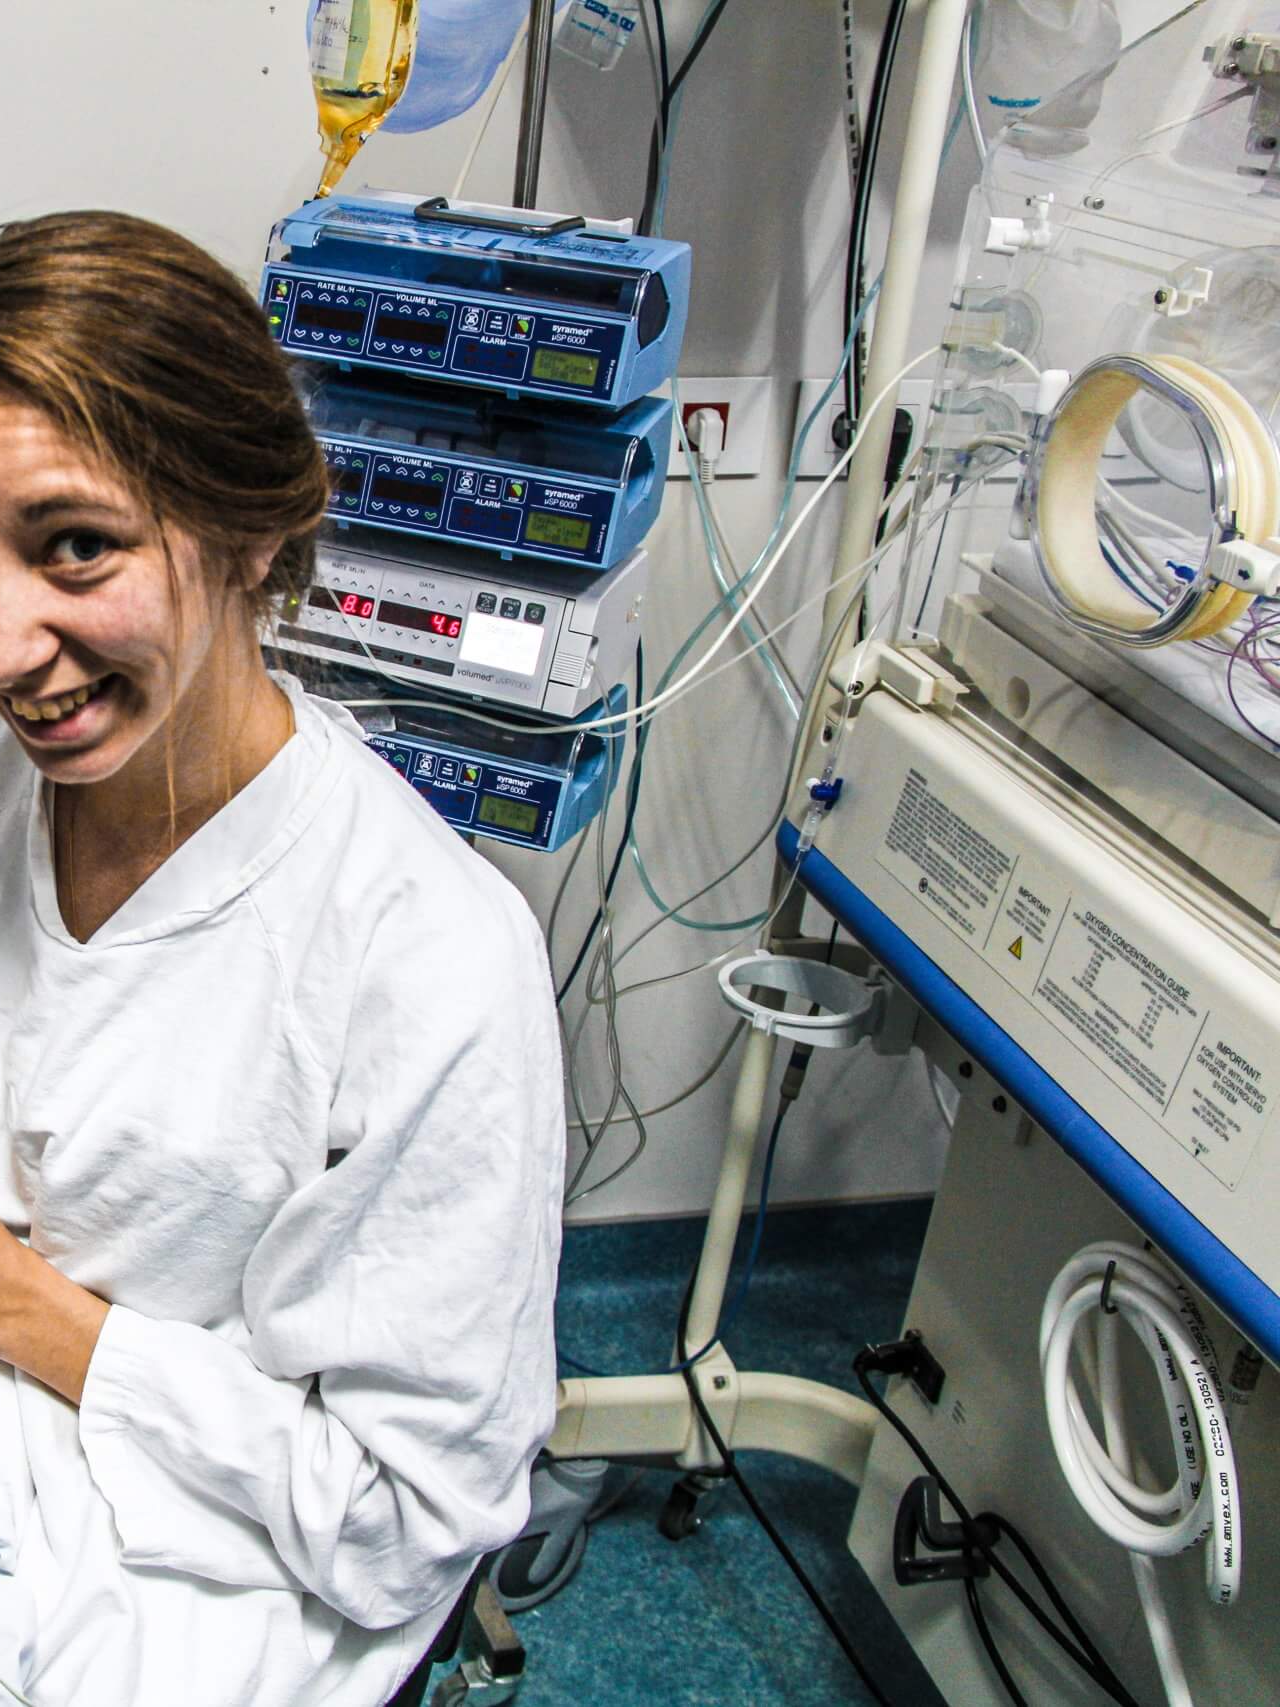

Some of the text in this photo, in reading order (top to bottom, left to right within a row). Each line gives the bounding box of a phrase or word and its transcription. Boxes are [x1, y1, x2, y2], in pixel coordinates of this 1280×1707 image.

[317, 282, 356, 293] RATE ML/H
[396, 293, 439, 306] VOLUME ML
[479, 336, 507, 346] ALARM
[567, 336, 587, 345] 6000
[392, 455, 434, 469] VOLUME ML
[474, 498, 501, 509] ALARM
[559, 500, 578, 509] 6000
[418, 581, 436, 590] DATA
[342, 594, 373, 617] 8.0
[431, 615, 461, 637] 4.6
[386, 742, 397, 750] ML
[433, 779, 458, 791] ALARM
[510, 786, 527, 796] 6000
[1018, 886, 1052, 917] IMPORTANT
[1084, 910, 1112, 938] OXYGEN
[1110, 931, 1167, 983] CONCENTRATION
[1165, 976, 1189, 1002] GUIDE
[1201, 1045, 1267, 1104] FOR USE WITH SERVO
[1196, 1054, 1263, 1114] OXYGEN CONTROLLED
[1212, 1080, 1238, 1105] SYSTEM
[1190, 1358, 1201, 1367] A
[1182, 1430, 1192, 1443] NO
